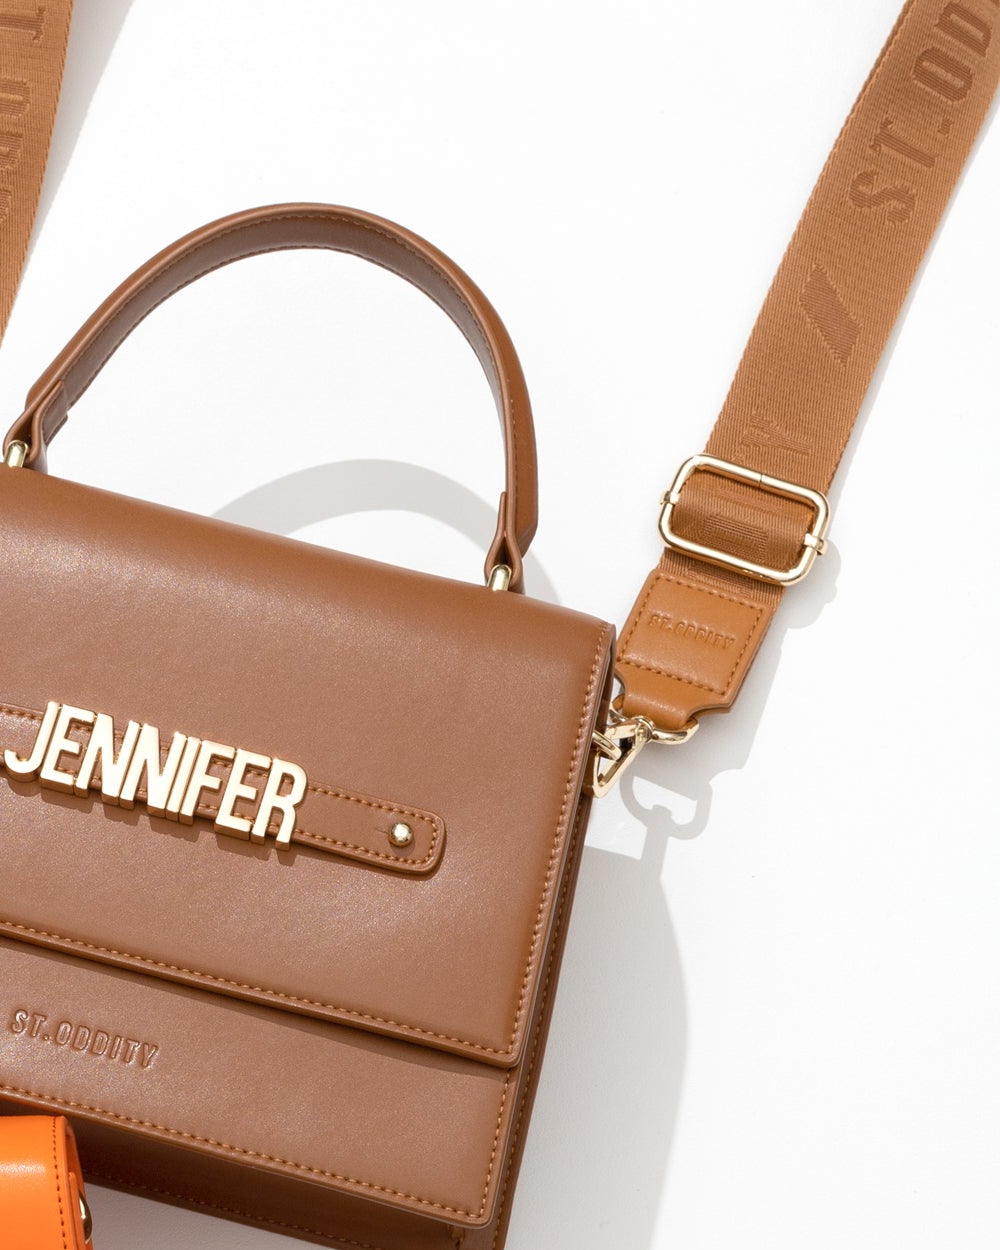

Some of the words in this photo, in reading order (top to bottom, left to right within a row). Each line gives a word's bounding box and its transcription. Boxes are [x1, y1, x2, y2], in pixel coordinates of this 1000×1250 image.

[849, 0, 1000, 227] ST.OD
[3, 700, 308, 851] JENNIFER
[9, 1008, 160, 1069] ST.ODDITY
